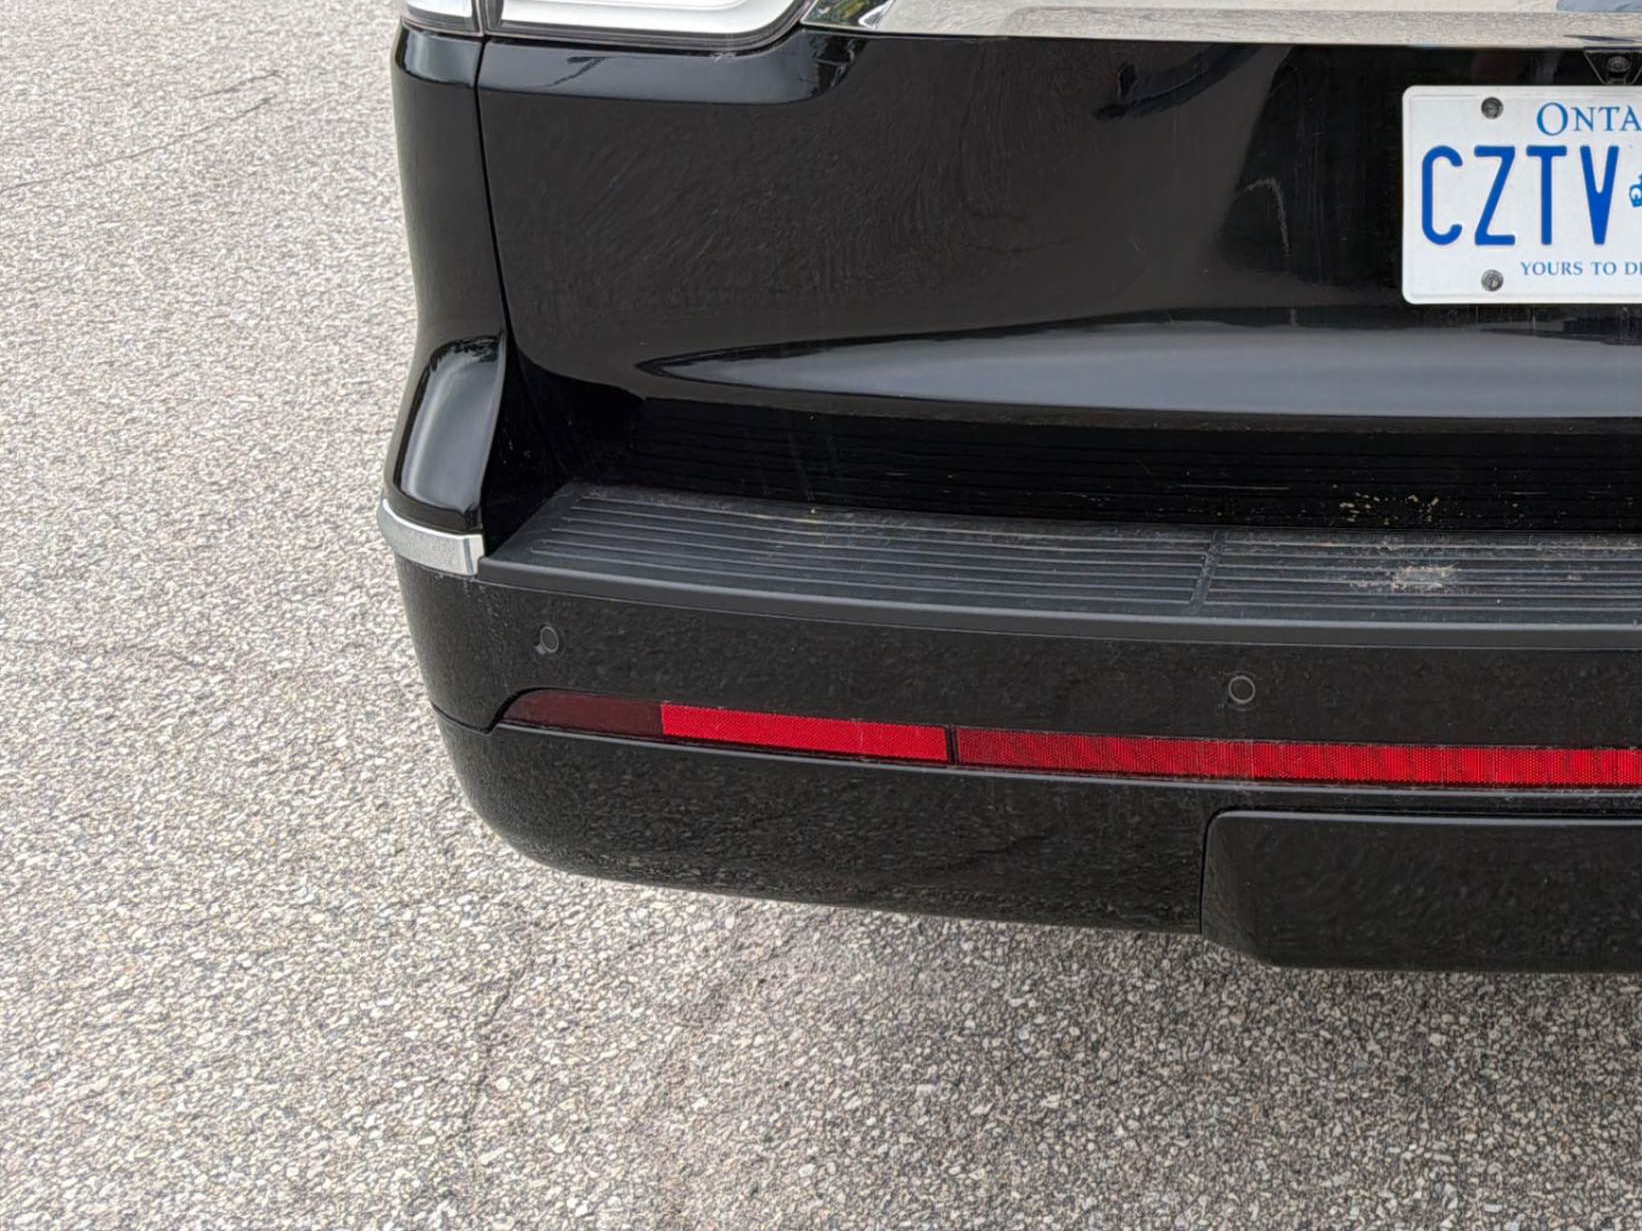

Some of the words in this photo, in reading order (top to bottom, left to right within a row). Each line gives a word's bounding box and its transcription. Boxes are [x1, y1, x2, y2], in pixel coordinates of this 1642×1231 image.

[1421, 145, 1620, 246] CZTV
[1520, 261, 1583, 276] YOURS
[1593, 261, 1617, 276] TO
